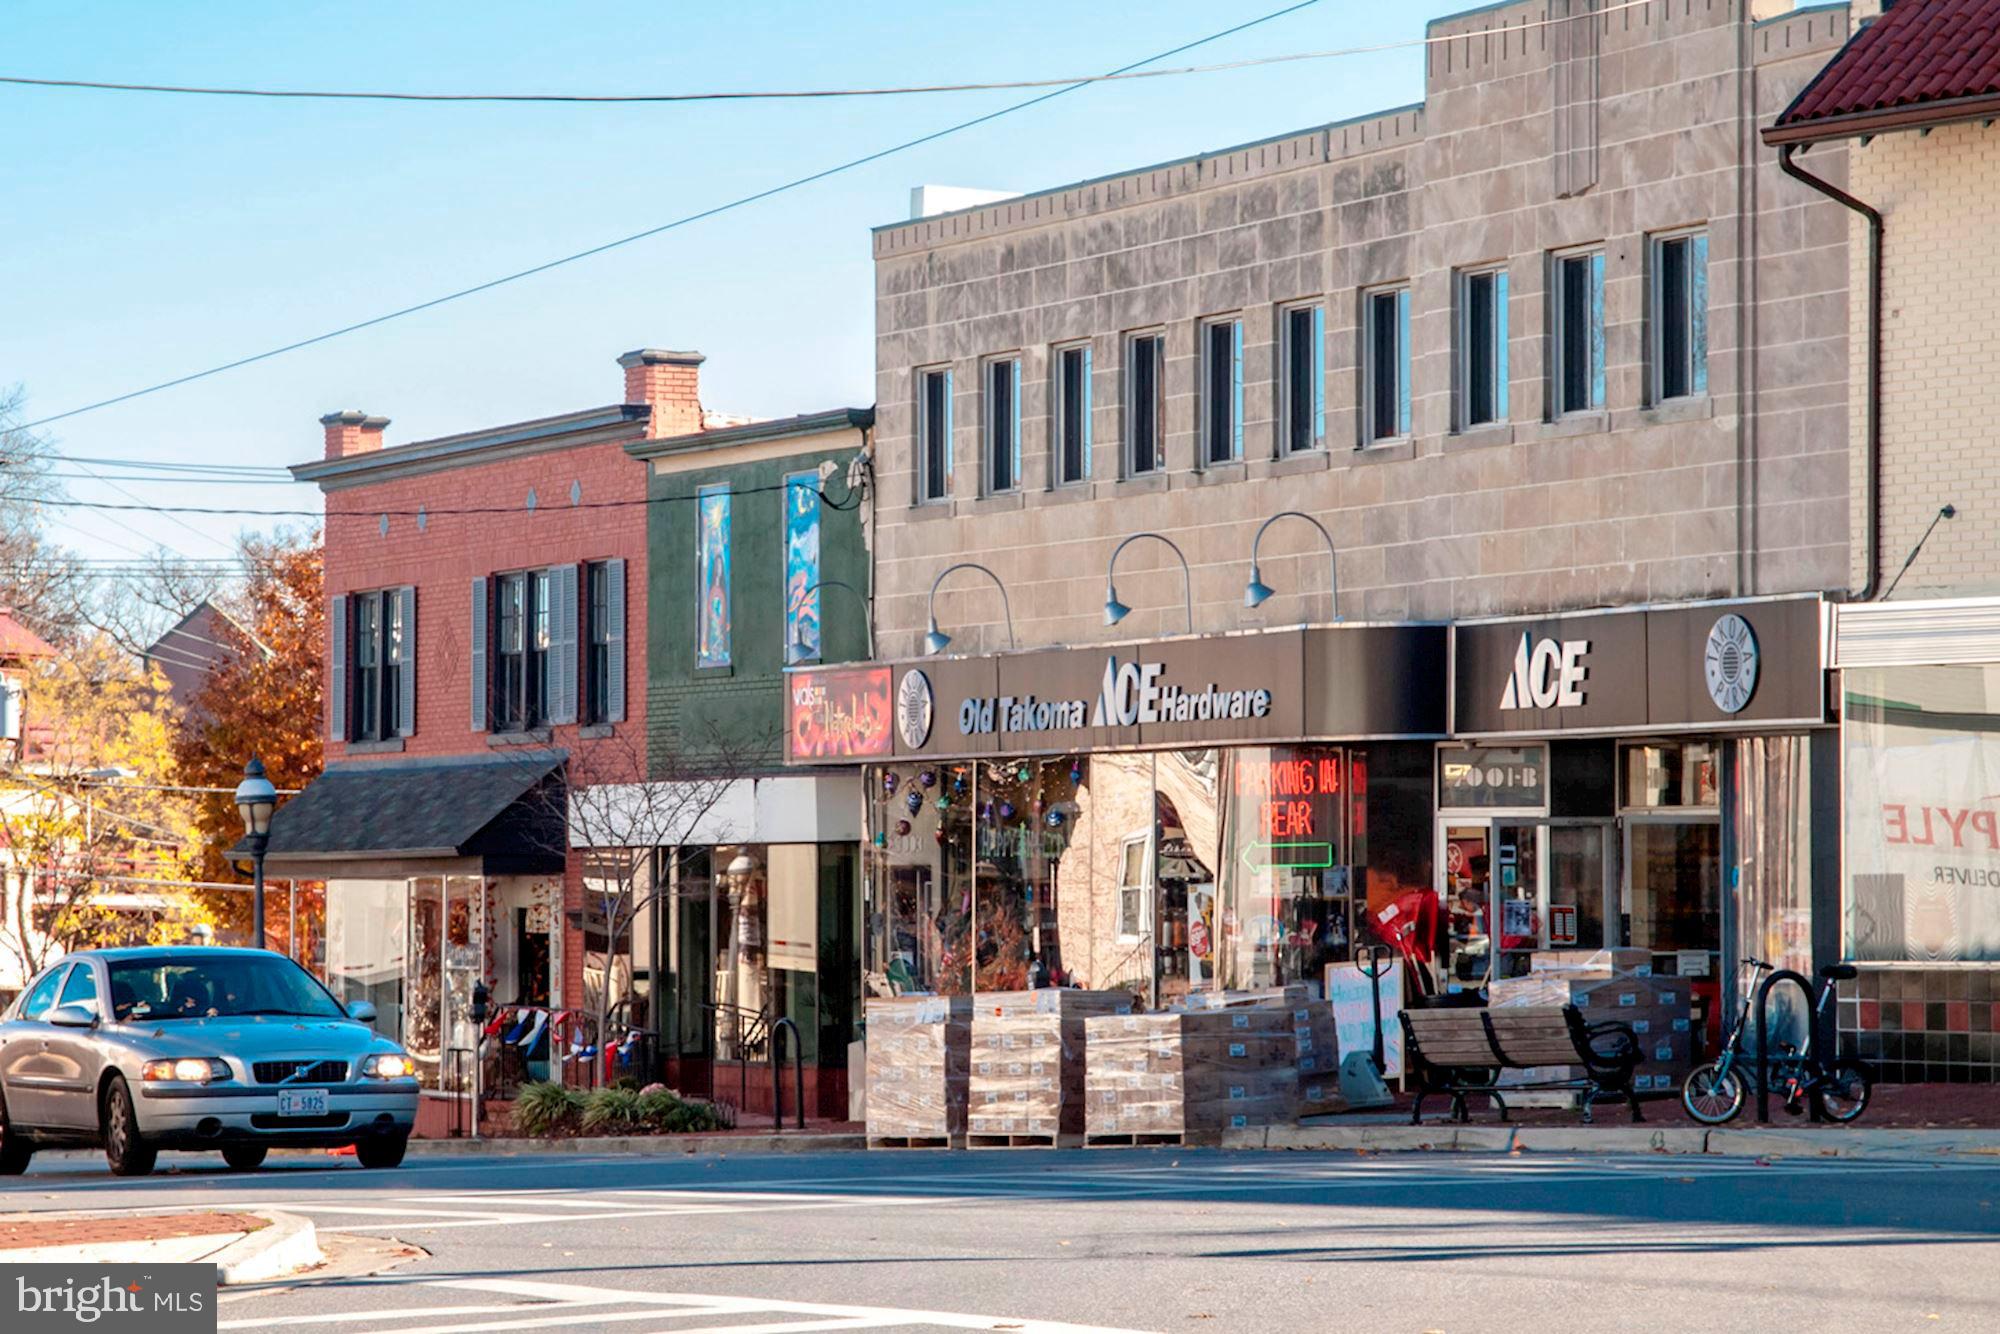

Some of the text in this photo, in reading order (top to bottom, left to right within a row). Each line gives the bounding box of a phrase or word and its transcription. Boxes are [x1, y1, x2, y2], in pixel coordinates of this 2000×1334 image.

[1706, 616, 1754, 664] TAKOMA
[1500, 631, 1590, 709] ACE
[959, 656, 1271, 735] Old Takoma ACE Hardware
[1713, 679, 1749, 709] PARK
[1235, 760, 1315, 795] PARKING
[1319, 759, 1339, 794] IN
[1260, 801, 1313, 837] REAR
